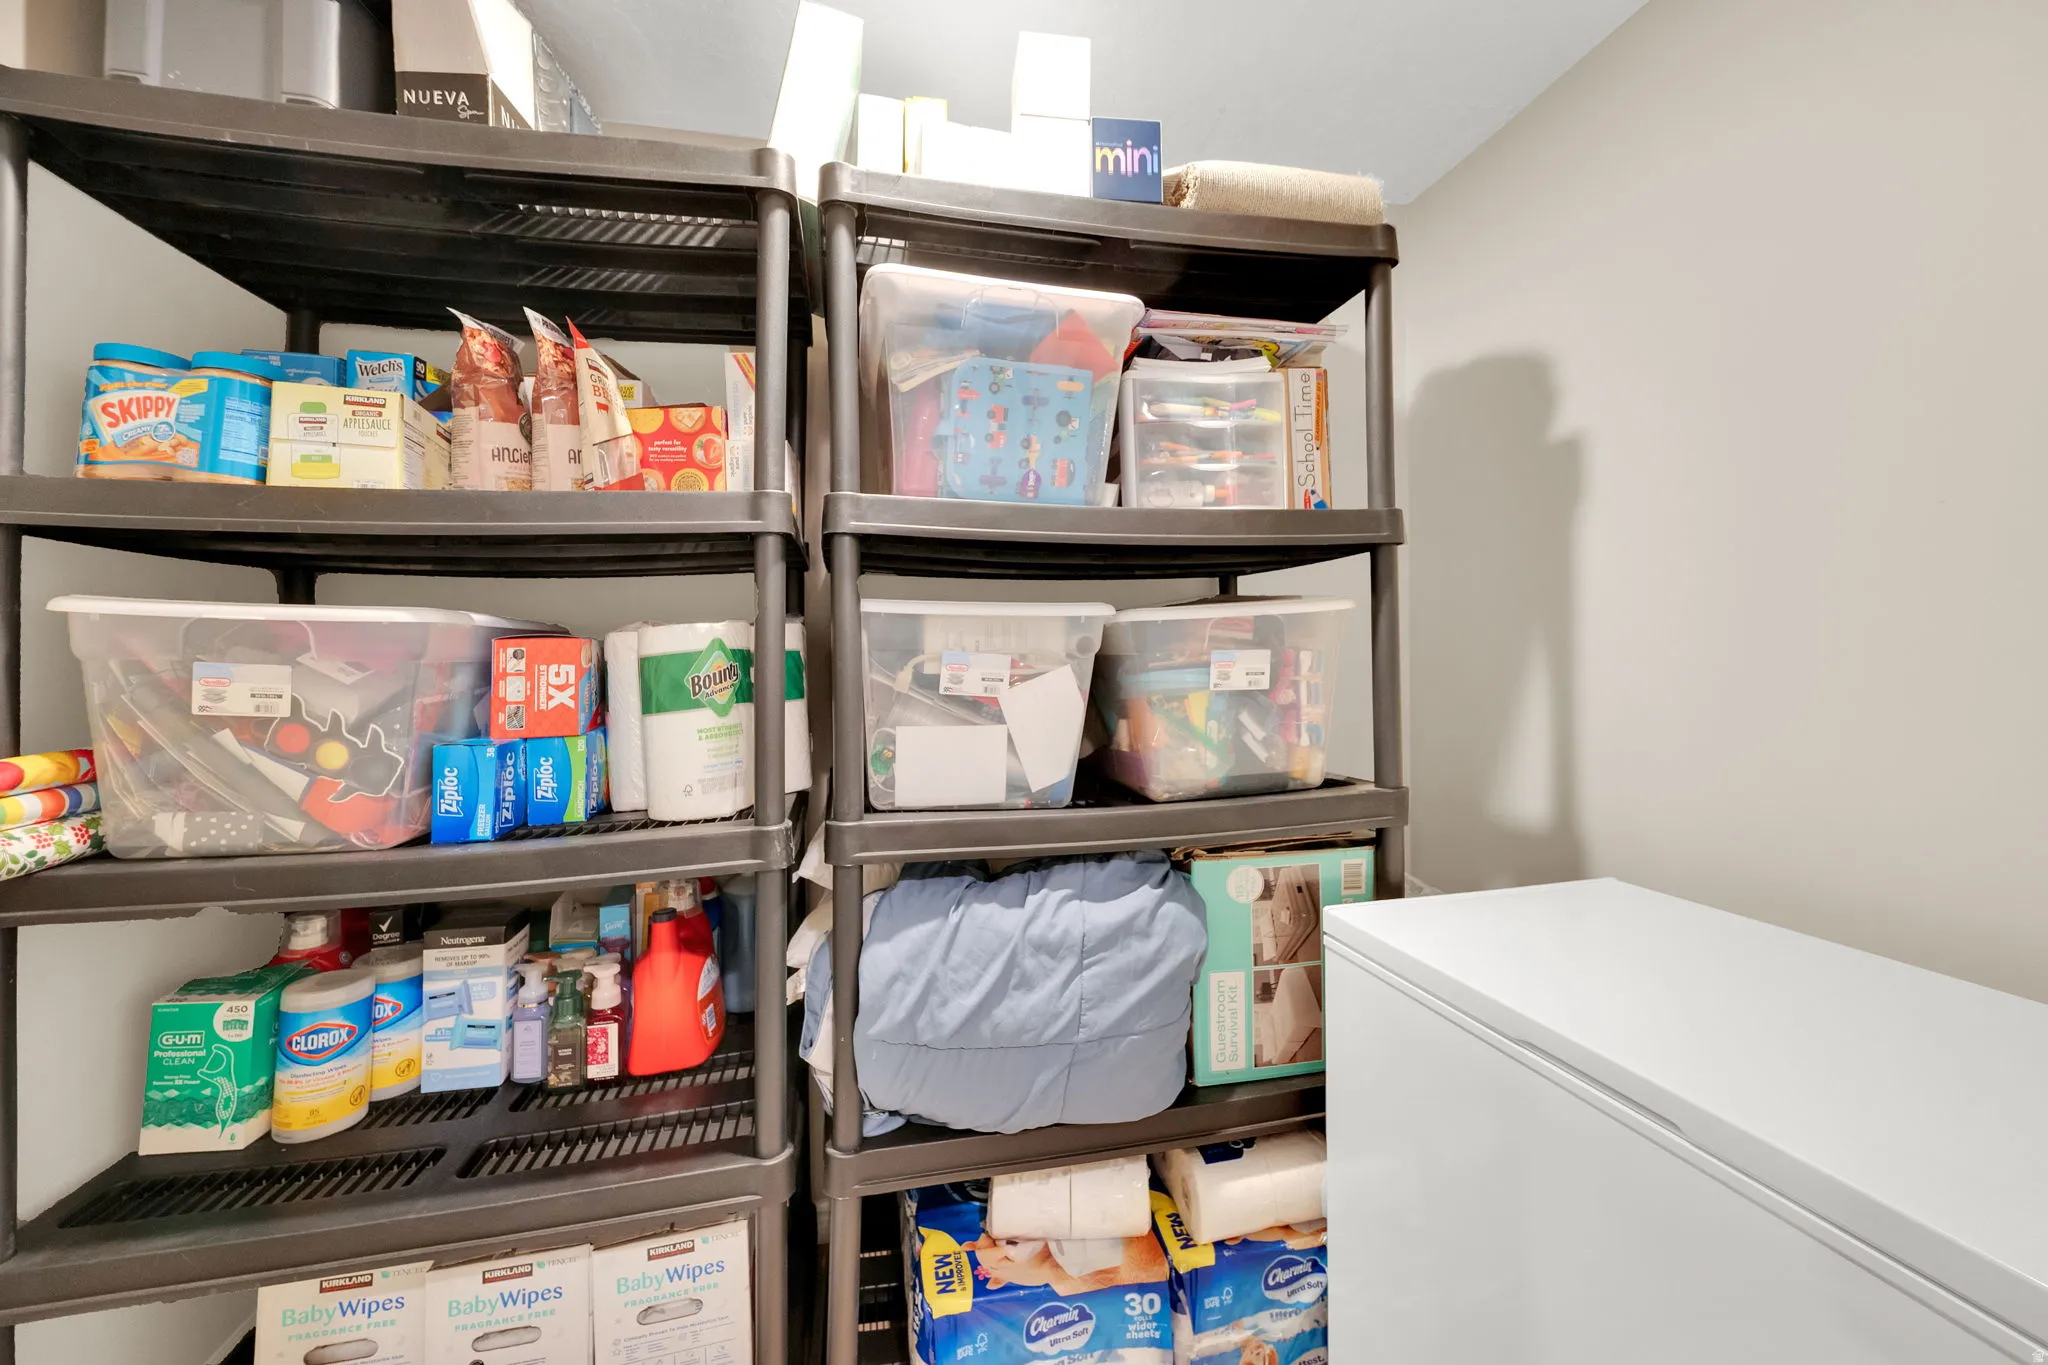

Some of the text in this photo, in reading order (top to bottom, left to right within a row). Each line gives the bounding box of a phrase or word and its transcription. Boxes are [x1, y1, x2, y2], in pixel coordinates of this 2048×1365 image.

[403, 89, 470, 106] NUEVA
[1095, 139, 1159, 178] mini
[357, 359, 404, 377] Welch's
[415, 360, 426, 375] 90
[345, 394, 386, 405] KIRKLAND
[100, 395, 176, 429] SKIPPY
[342, 418, 392, 431] APPLESAUCE
[1294, 373, 1316, 487] School Time
[653, 439, 673, 447] perfect
[539, 664, 548, 711] STRONGER
[547, 663, 576, 711] 5X
[690, 661, 740, 699] Bounty
[486, 747, 496, 759] 38
[502, 751, 516, 823] Ziploc
[536, 756, 558, 799] Ziploc
[589, 752, 599, 811] Ziploc
[440, 767, 464, 814] Ziploc
[576, 780, 585, 818] SANDWICH
[477, 803, 486, 837] FREEZER
[372, 931, 400, 941] Degree
[440, 935, 486, 946] Neutrogena
[435, 955, 461, 963] REMOVES
[454, 959, 478, 967] MAKEUP
[226, 1005, 249, 1013] 450
[1216, 979, 1226, 1064] Guestroom
[1228, 985, 1238, 1063] Survival Kit
[291, 1027, 349, 1052] CLOROX
[153, 1049, 206, 1058] Professional
[162, 1058, 196, 1066] CLEAN
[290, 1063, 347, 1080] Disinfecting Wipes
[1165, 1212, 1198, 1250] NEW
[649, 1240, 694, 1257] KIRKLAND
[321, 1273, 373, 1289] KIRKLAND
[484, 1264, 532, 1279] KIRKLAND
[932, 1252, 957, 1295] NEW
[1268, 1260, 1313, 1286] Charmin
[623, 1282, 720, 1309] FRAGRANCE FREE
[1306, 1280, 1324, 1290] Soft
[1124, 1292, 1162, 1317] 30
[287, 1319, 397, 1342] FRAGRANCE FREE
[454, 1308, 557, 1333] FRAGRANCE FREE
[1030, 1307, 1080, 1337] Charmin
[1127, 1321, 1158, 1332] wider
[1049, 1326, 1090, 1348] Ultra Soft
[1125, 1329, 1161, 1340] sheets
